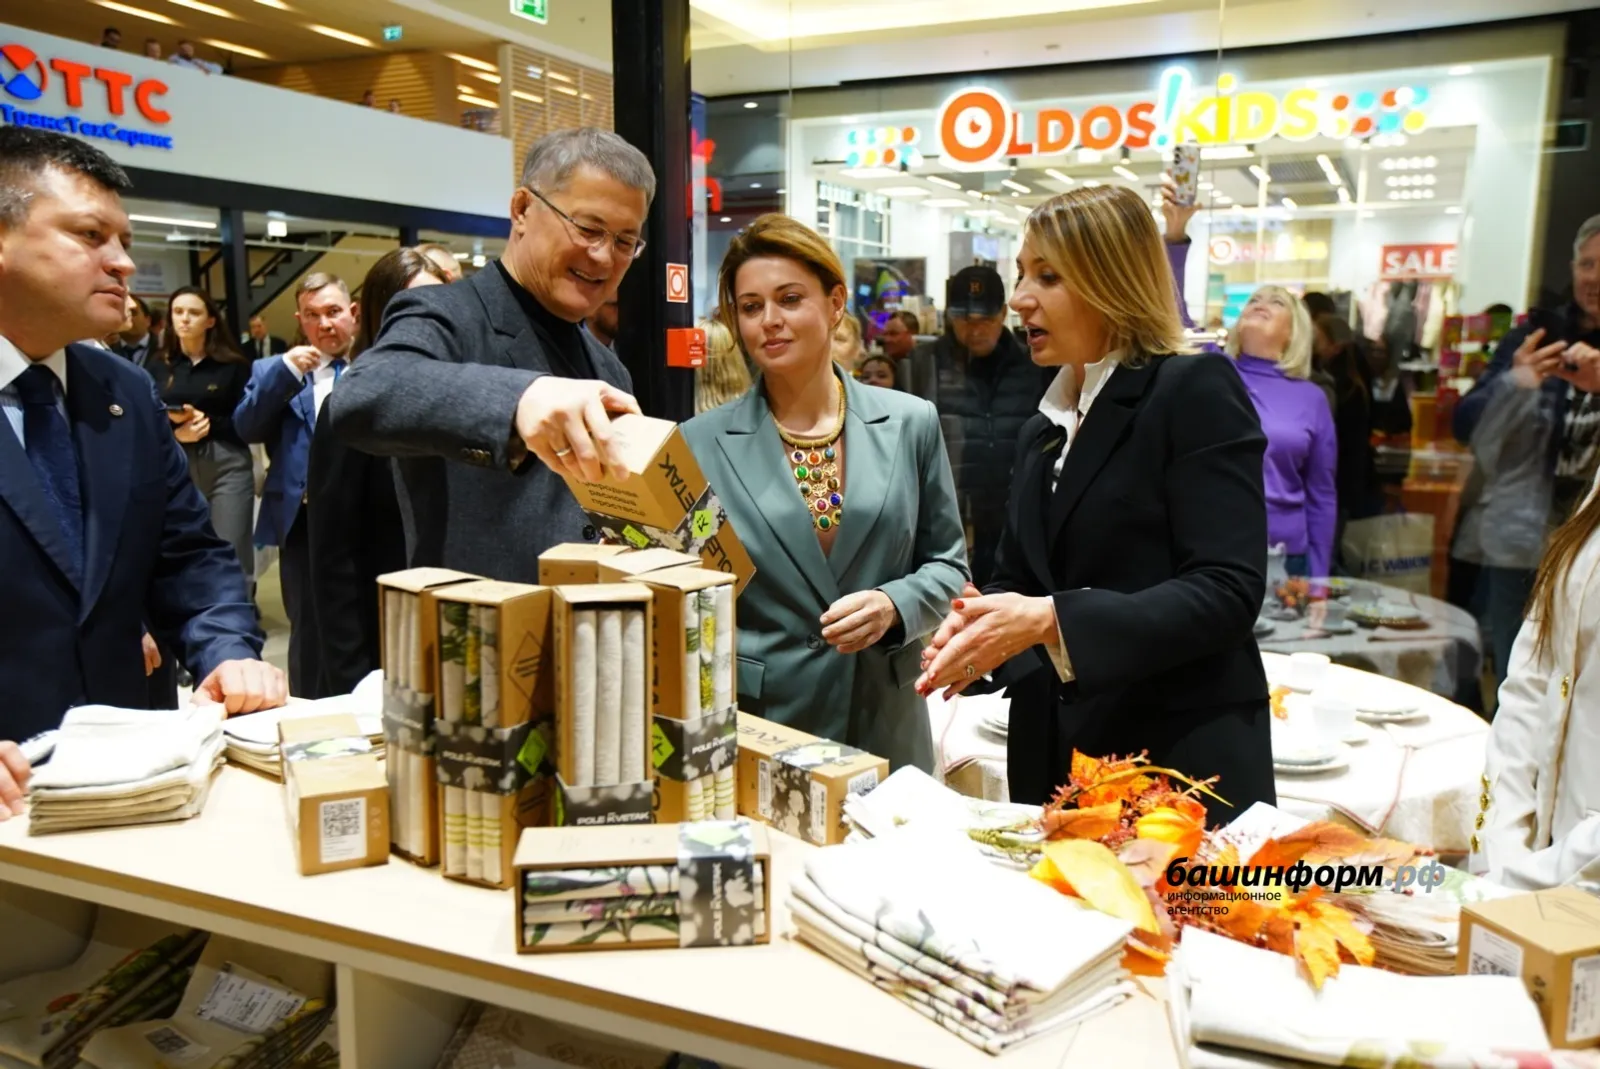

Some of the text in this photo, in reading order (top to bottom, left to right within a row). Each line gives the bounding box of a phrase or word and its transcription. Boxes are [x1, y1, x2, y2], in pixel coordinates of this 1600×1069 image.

[50, 57, 171, 124] ТТС
[1385, 249, 1457, 275] SALE
[576, 815, 606, 826] POLE
